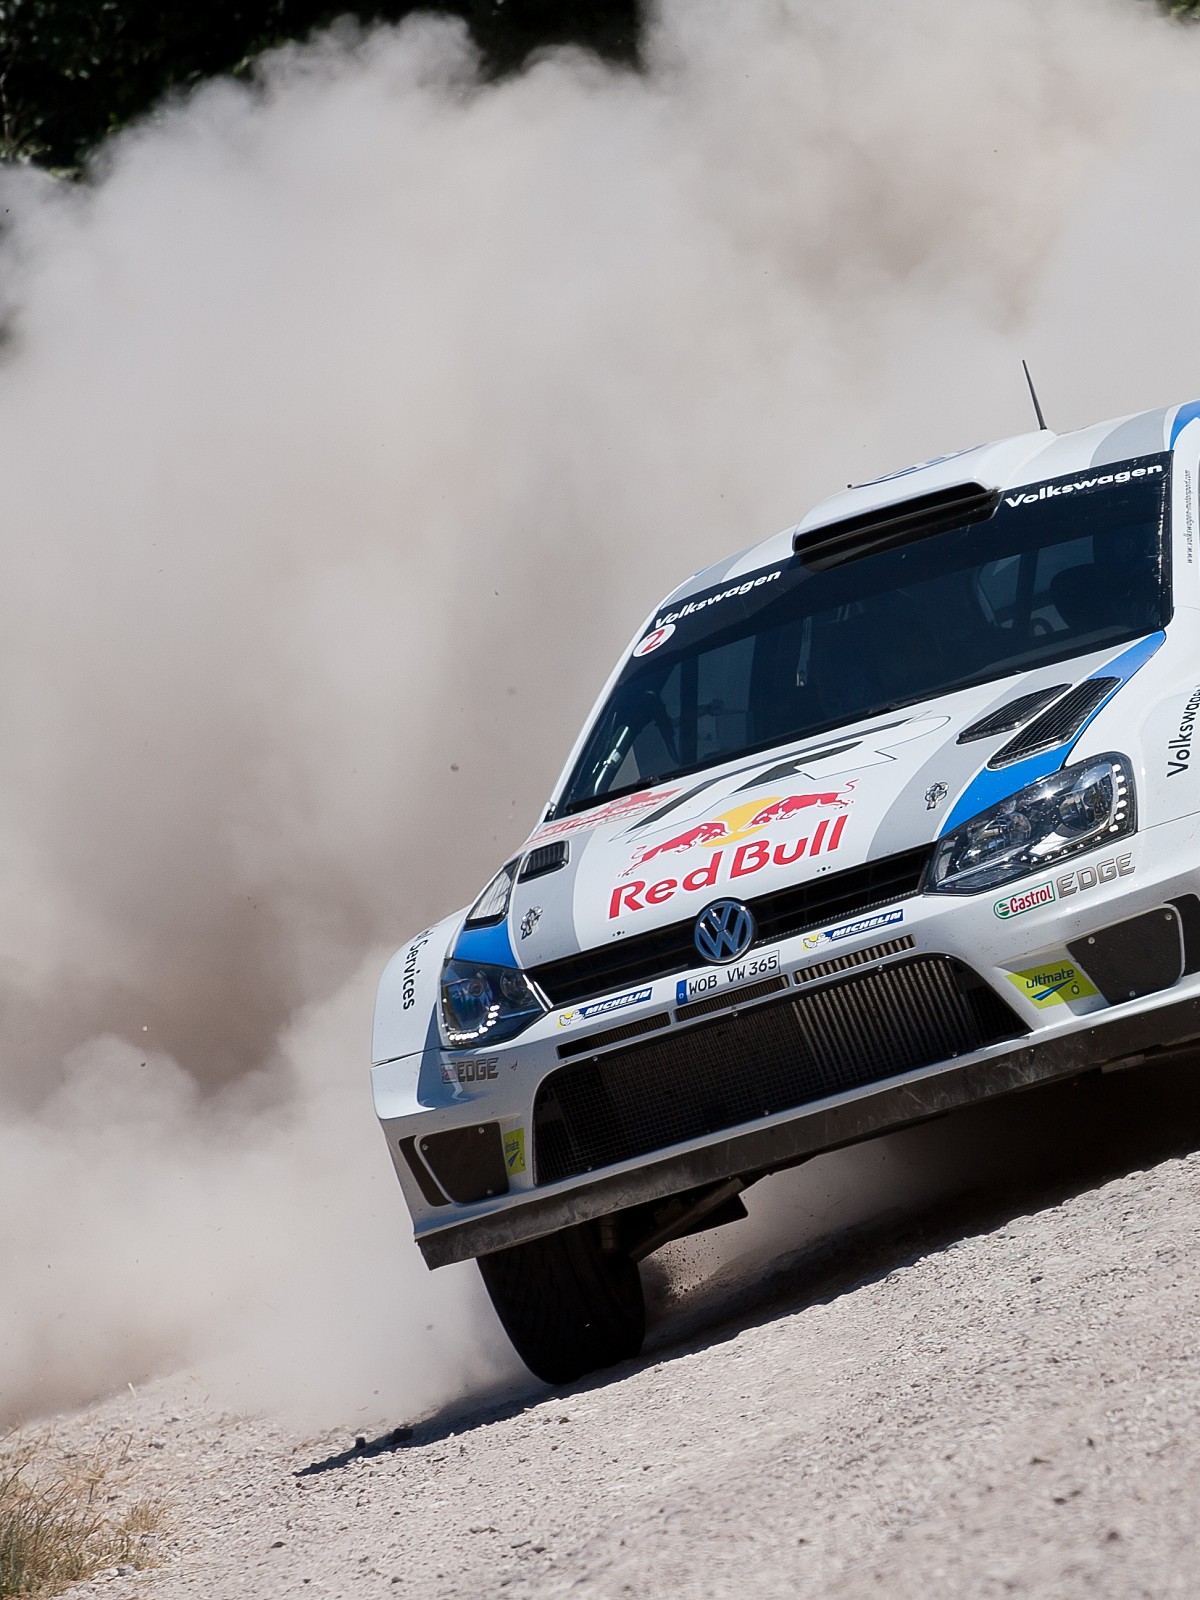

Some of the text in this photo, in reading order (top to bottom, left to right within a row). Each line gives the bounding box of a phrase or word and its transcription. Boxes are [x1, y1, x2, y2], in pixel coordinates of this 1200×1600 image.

[1004, 464, 1163, 508] Volkswagen
[655, 571, 782, 629] Volkswagen
[608, 851, 721, 920] Red
[729, 814, 849, 880] Bull
[1009, 853, 1135, 914] Castrol EDGE
[831, 911, 903, 939] MICHELIN
[402, 939, 428, 1011] Services
[688, 975, 718, 996] WOB
[727, 965, 747, 983] VW
[749, 955, 778, 976] 365
[1025, 966, 1075, 990] ultimate
[584, 989, 651, 1015] MICHELIN
[457, 1057, 500, 1083] EDGE
